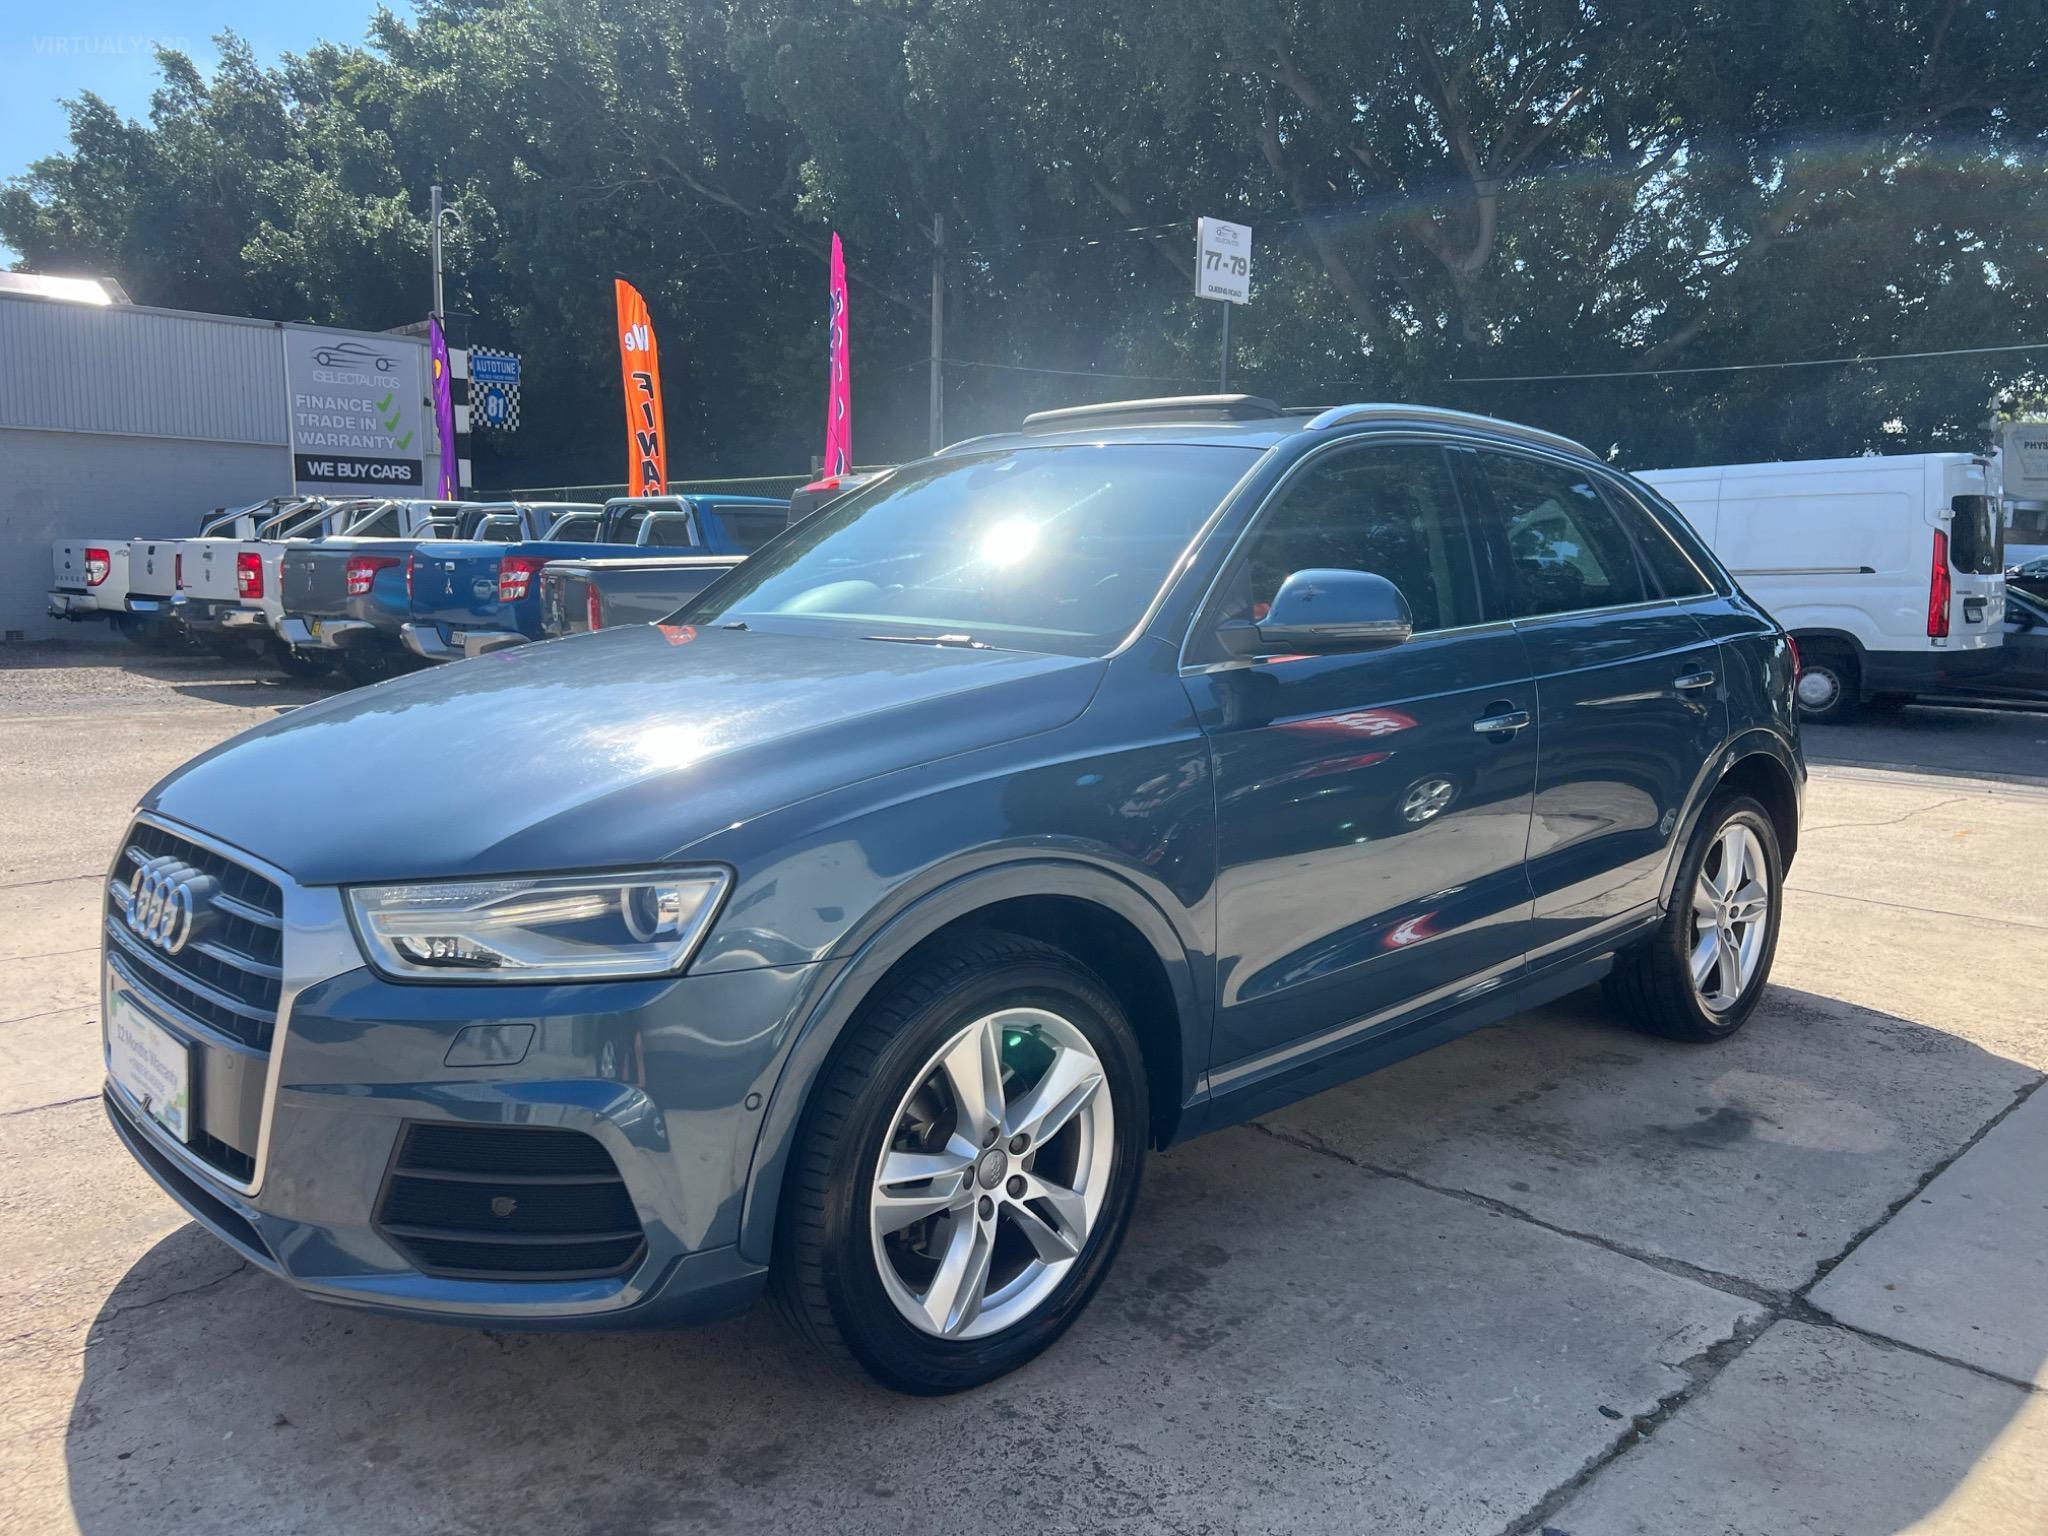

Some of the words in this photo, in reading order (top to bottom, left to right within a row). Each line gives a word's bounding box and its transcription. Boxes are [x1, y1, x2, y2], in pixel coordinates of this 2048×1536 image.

[476, 359, 516, 375] AUTOTUNE
[295, 393, 373, 413] FINANCE
[487, 395, 505, 418] 81
[297, 412, 356, 430] TRADE
[360, 418, 377, 431] IN
[297, 431, 396, 450] WARRANTY
[307, 461, 335, 477] WE
[337, 463, 369, 478] BUY
[369, 465, 411, 480] CARS
